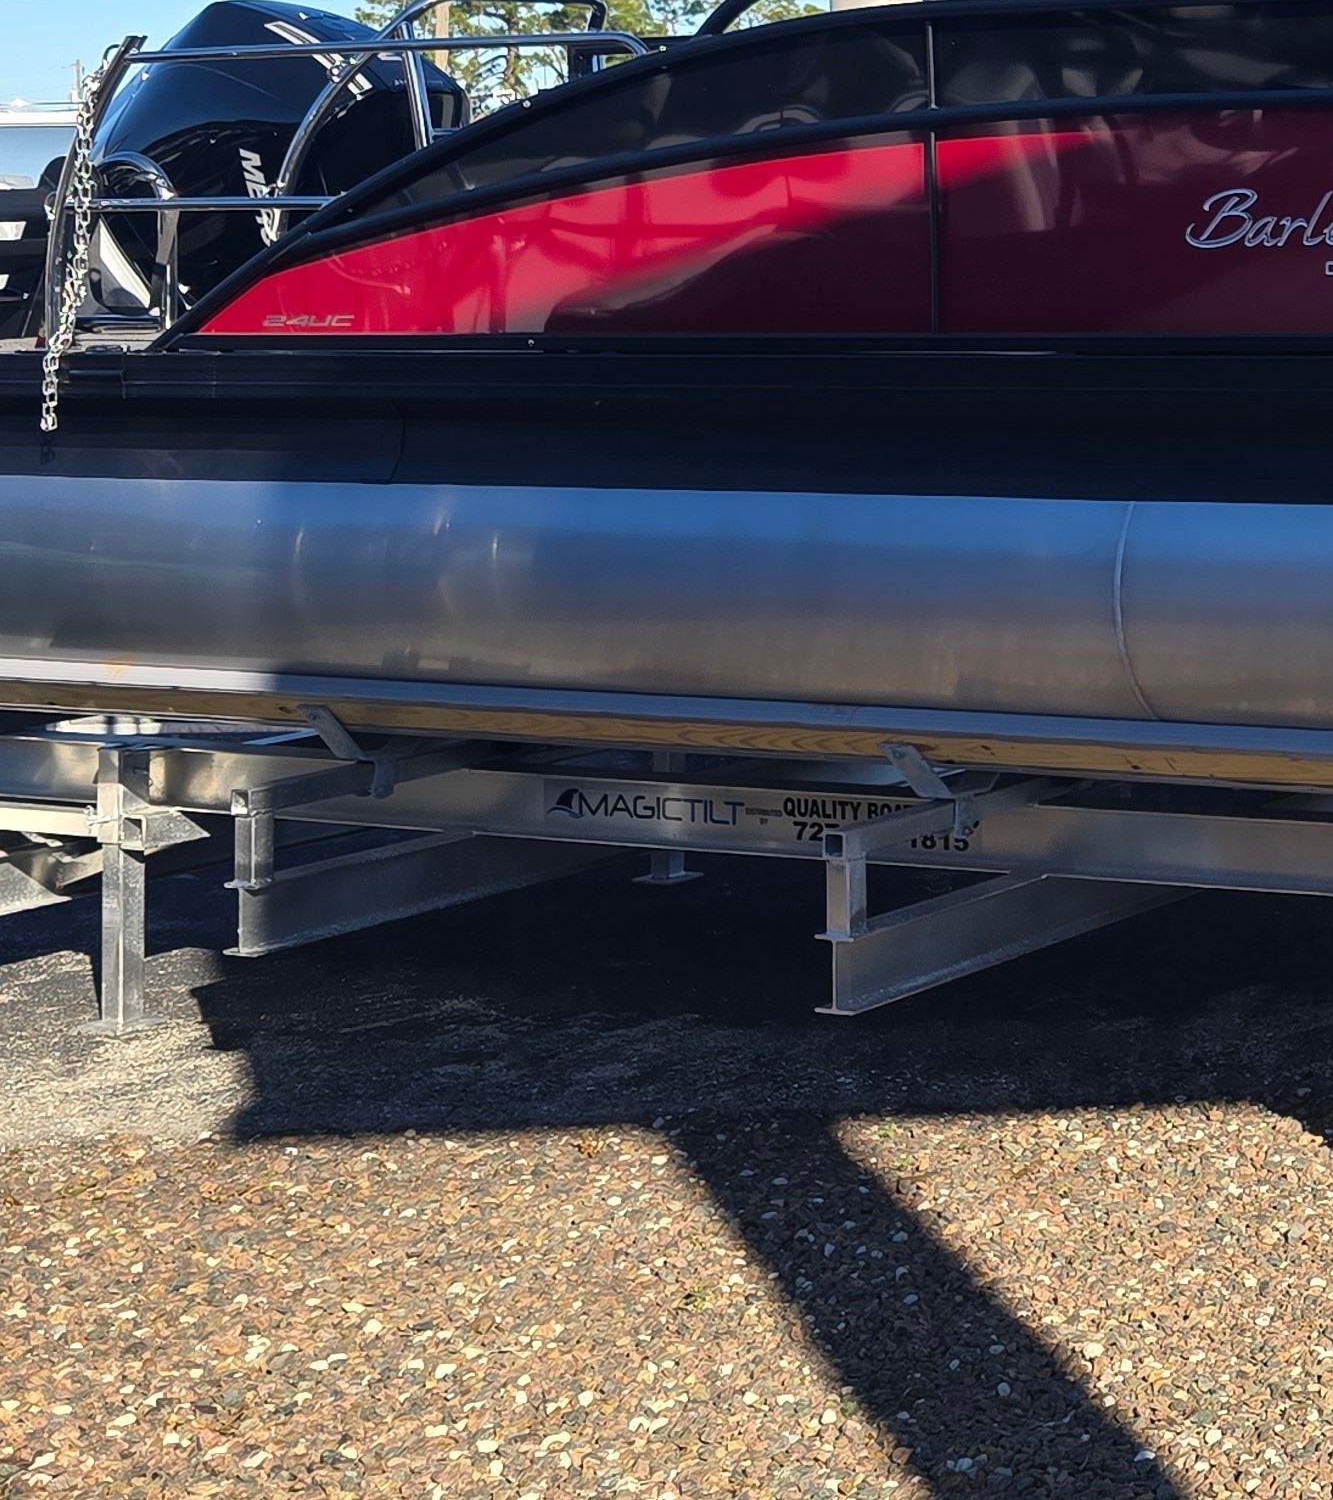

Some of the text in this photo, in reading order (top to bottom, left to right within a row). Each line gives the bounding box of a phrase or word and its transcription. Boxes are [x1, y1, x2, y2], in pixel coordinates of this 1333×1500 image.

[262, 314, 355, 327] 24UC
[577, 790, 745, 826] MAGICTILT
[783, 797, 861, 821] QUALITY
[867, 802, 914, 820] BO
[793, 821, 840, 842] 72
